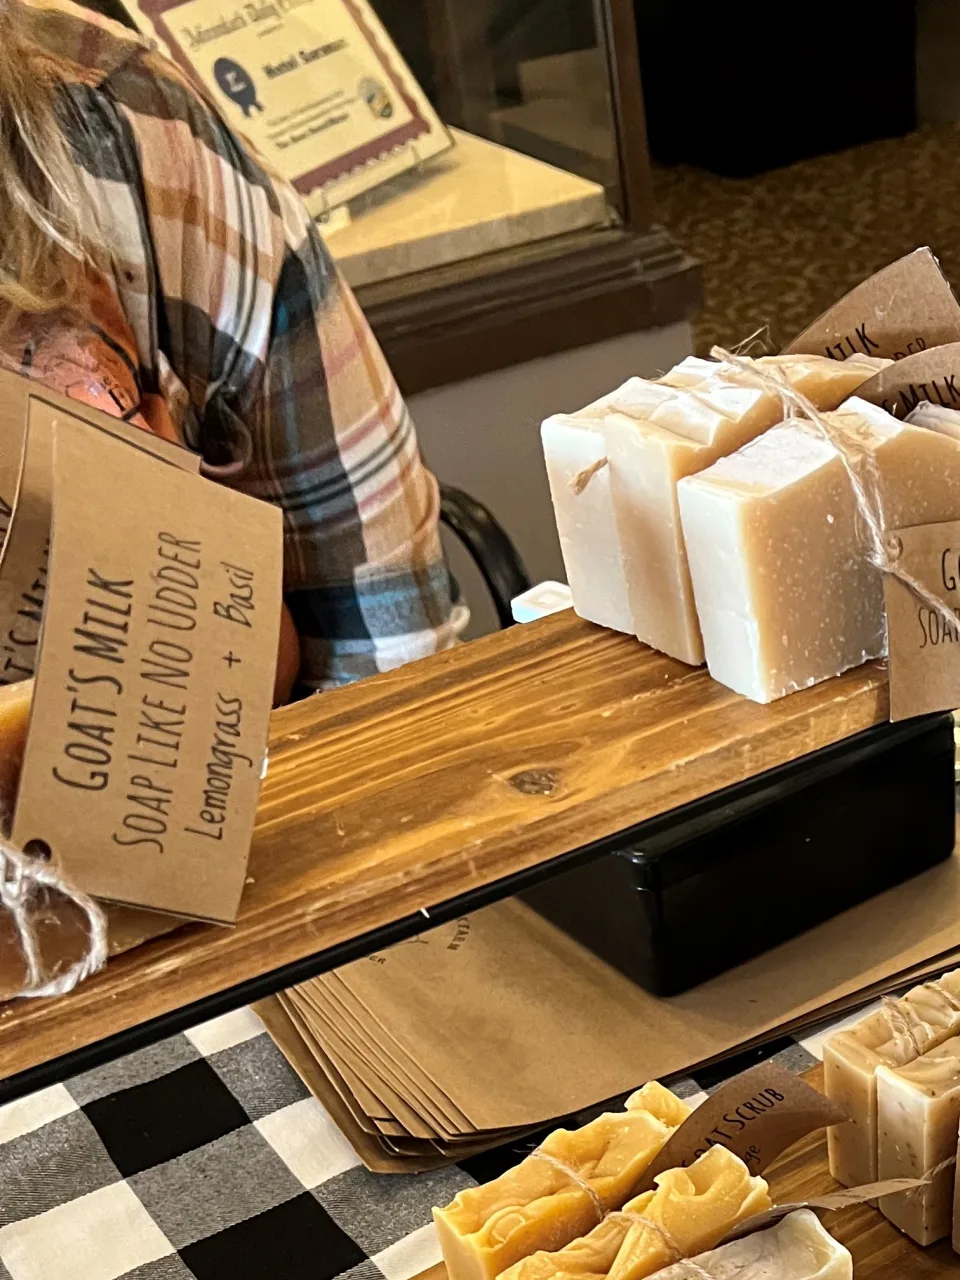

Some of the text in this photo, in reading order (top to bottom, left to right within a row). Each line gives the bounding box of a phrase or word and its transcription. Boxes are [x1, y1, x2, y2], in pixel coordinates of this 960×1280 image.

[52, 567, 134, 792] GOAT'S MILK
[112, 531, 202, 854] SOAP LIKE NO UDDER
[184, 561, 255, 841] Lemongrass + Basil
[723, 1087, 785, 1131] SCRUB
